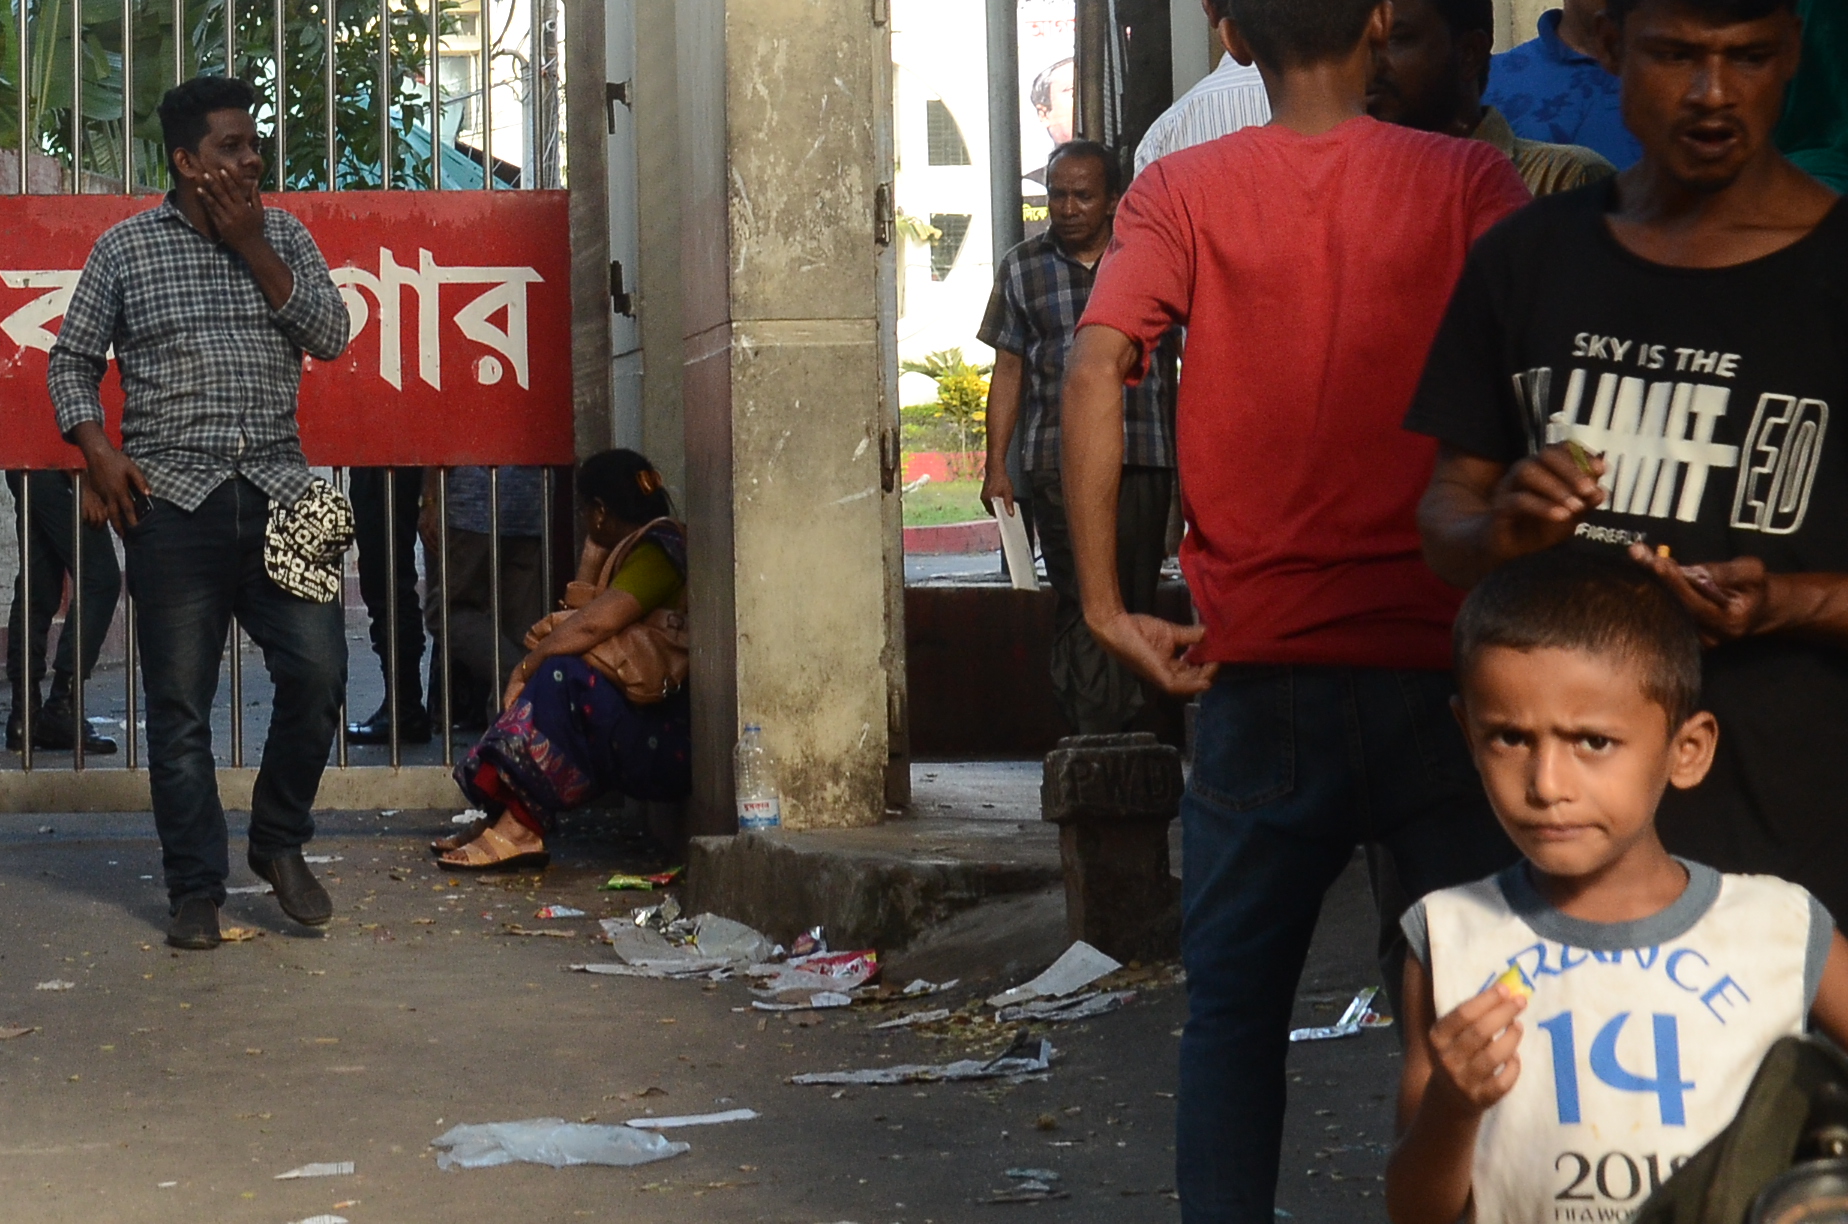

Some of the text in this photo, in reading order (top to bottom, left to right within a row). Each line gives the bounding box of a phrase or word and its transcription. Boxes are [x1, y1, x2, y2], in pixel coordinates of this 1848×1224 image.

[1571, 331, 1743, 378] SKY IS THE
[1537, 1009, 1697, 1128] 14
